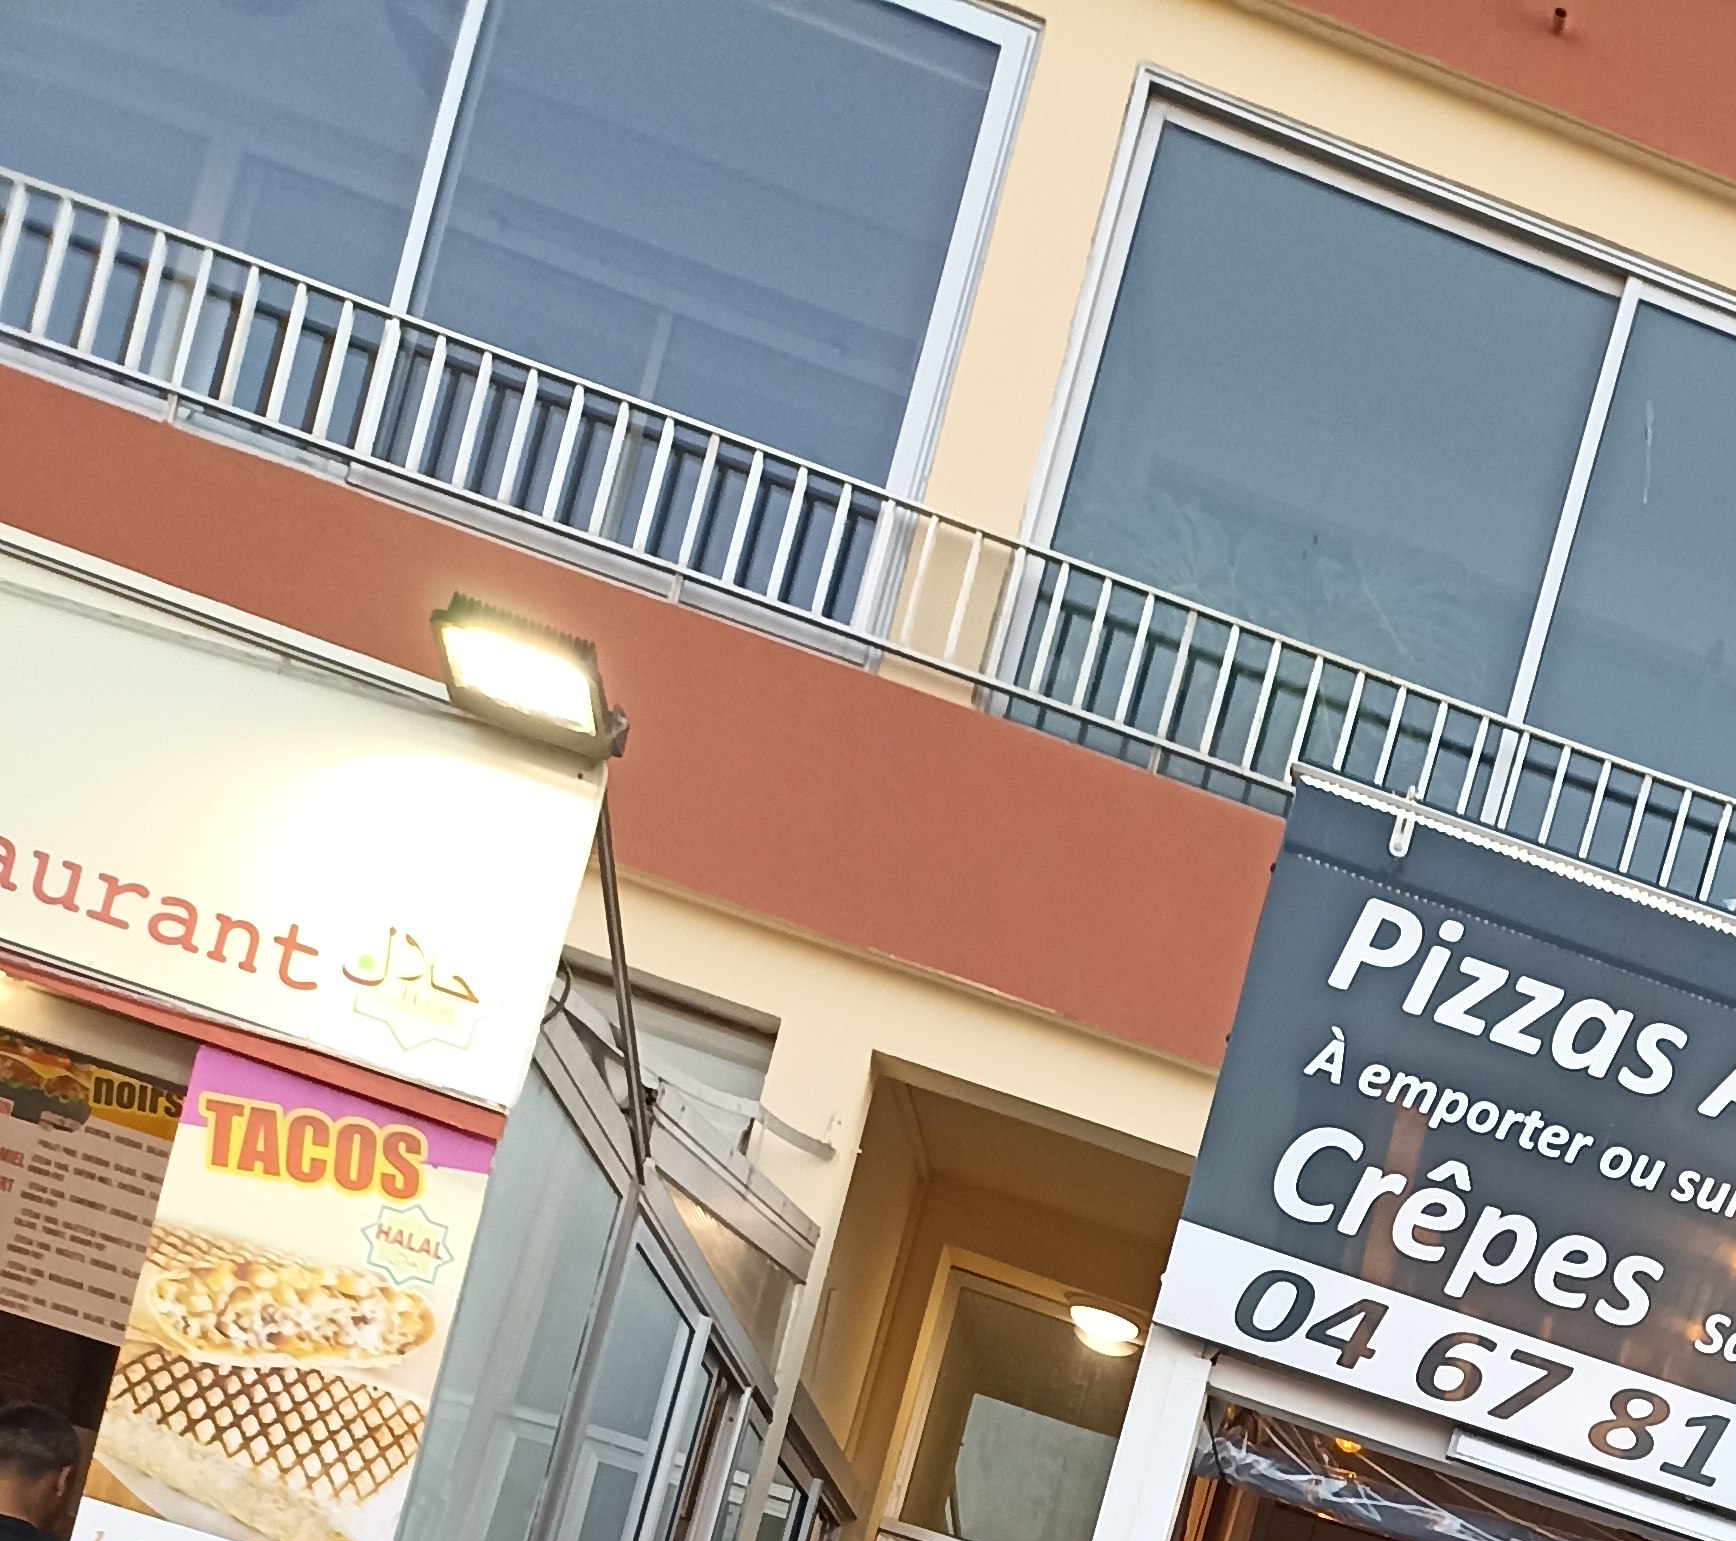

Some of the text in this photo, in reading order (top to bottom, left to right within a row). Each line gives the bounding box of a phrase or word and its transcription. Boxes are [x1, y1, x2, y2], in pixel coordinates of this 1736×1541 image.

[1327, 897, 1689, 1096] Pizzas
[205, 1097, 424, 1200] TACOS
[1303, 1025, 1348, 1086] À
[1357, 1051, 1594, 1170] emporter
[1598, 1141, 1667, 1193] ou
[375, 1223, 443, 1261] HALAL
[1273, 1126, 1666, 1329] Crêpes
[1234, 1268, 1389, 1371] 04
[1415, 1330, 1575, 1422] 67
[1589, 1387, 1735, 1487] 81
